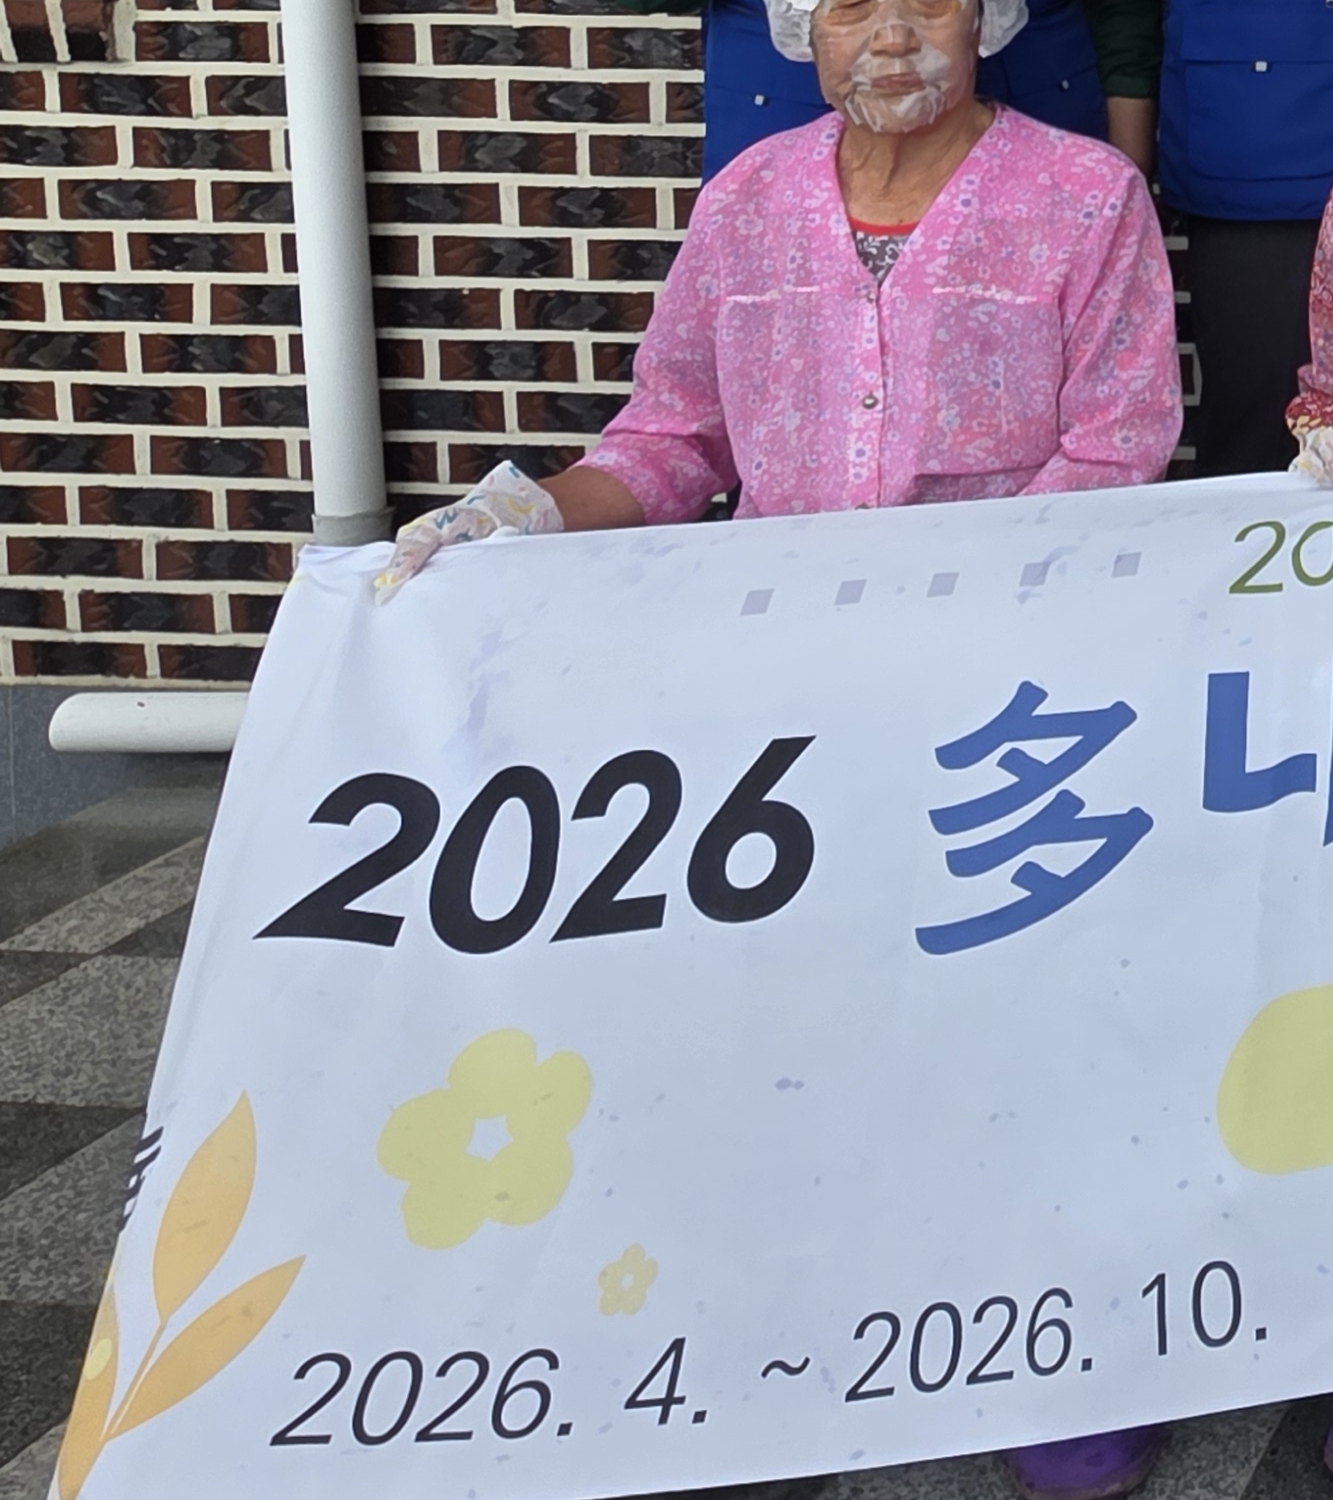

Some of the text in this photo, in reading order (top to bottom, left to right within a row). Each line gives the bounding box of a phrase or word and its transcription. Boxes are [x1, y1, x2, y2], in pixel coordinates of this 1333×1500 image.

[254, 736, 815, 954] 2026
[915, 681, 1153, 955] 多
[270, 1261, 1266, 1445] 2026. 4. ~ 2026. 10.
